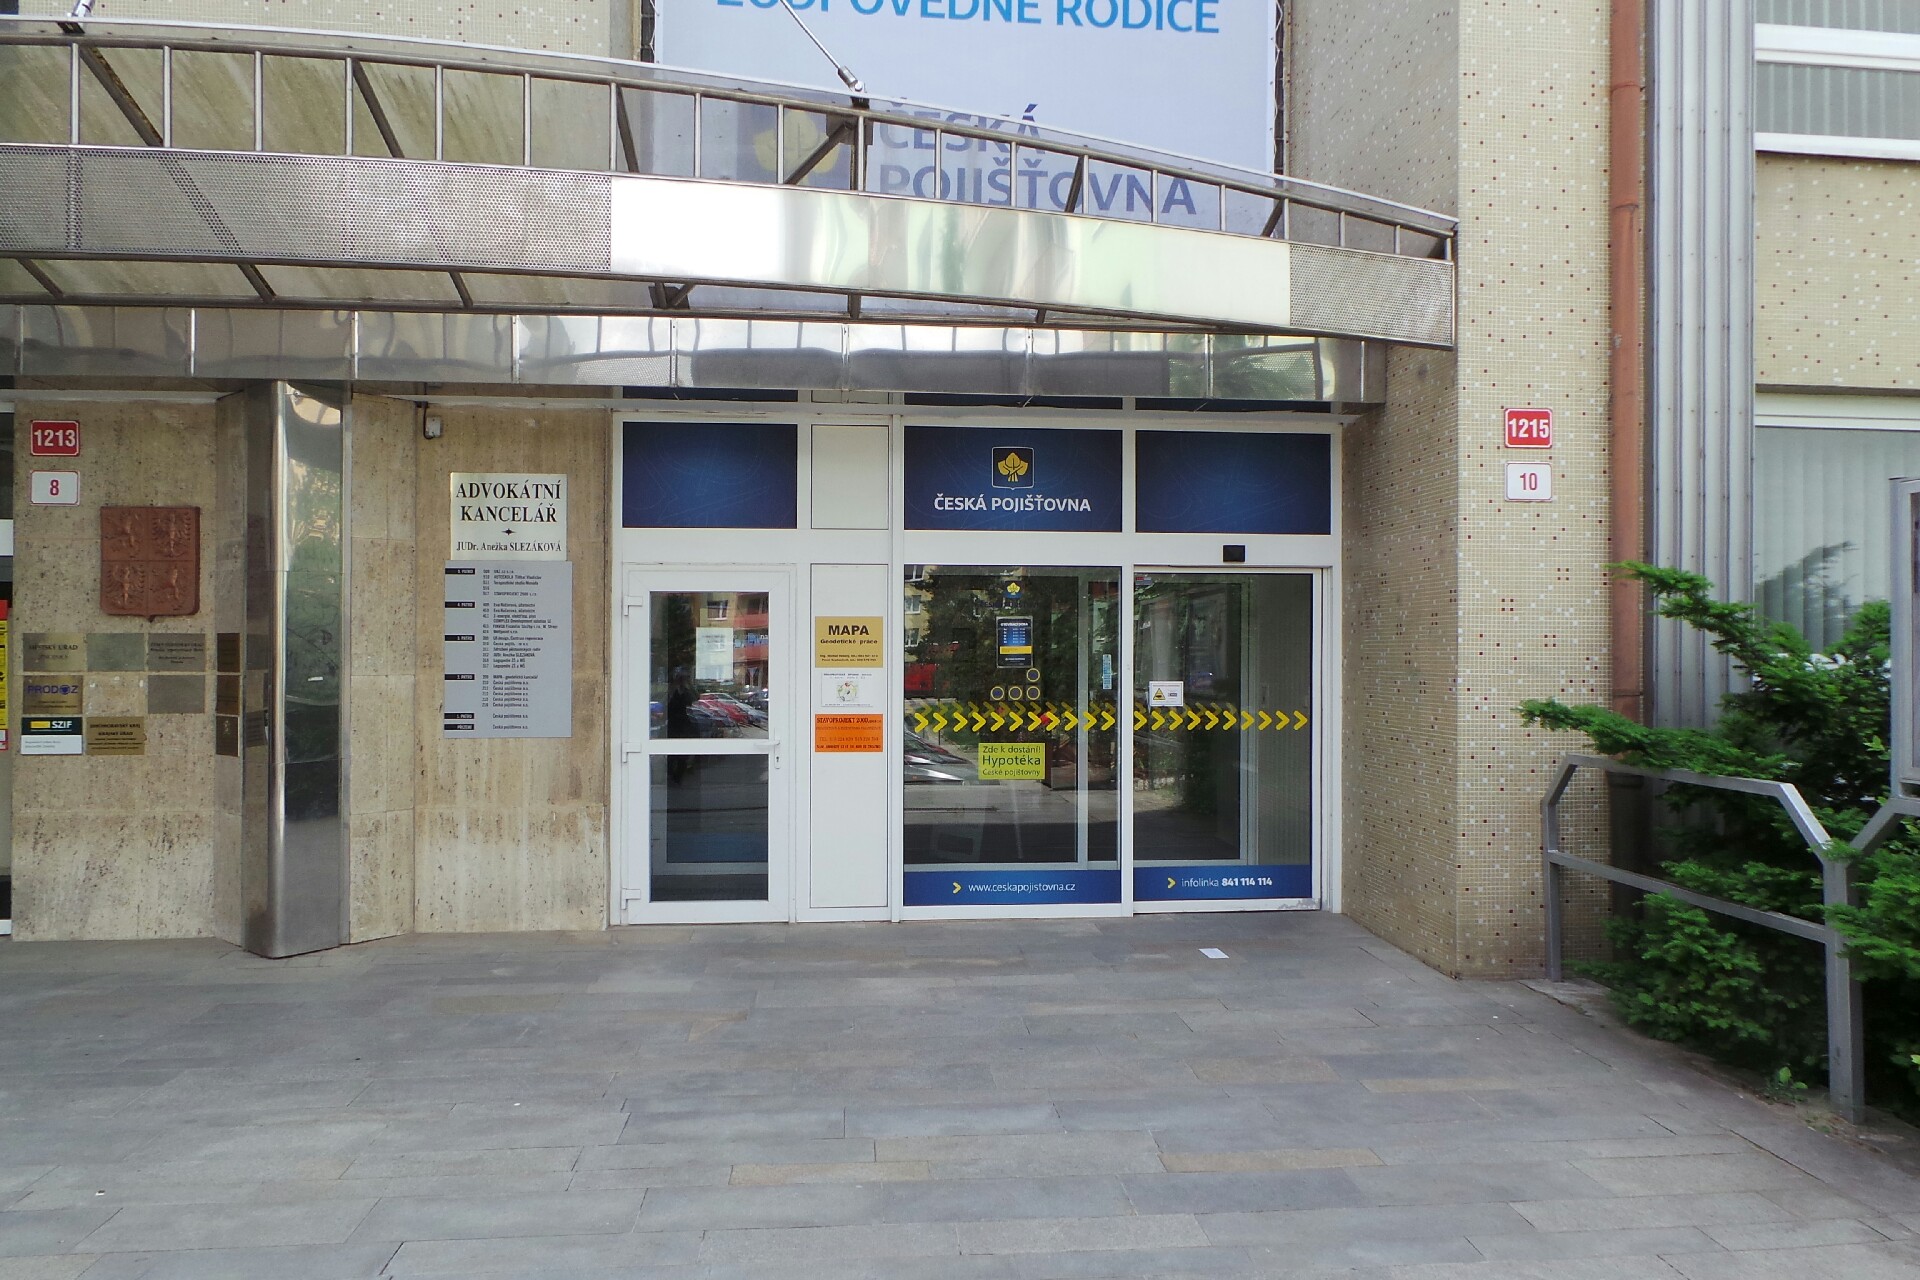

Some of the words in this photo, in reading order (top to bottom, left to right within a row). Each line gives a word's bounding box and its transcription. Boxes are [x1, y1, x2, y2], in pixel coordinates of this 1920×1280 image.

[1508, 418, 1550, 438] 1215
[33, 429, 76, 447] 1213
[49, 479, 59, 496] 8
[456, 479, 561, 499] ADVOKÁTNÍ
[1519, 473, 1538, 491] 10
[934, 493, 987, 511] ČESKÁ
[991, 493, 1091, 513] POJIŠŤOVNA
[460, 502, 557, 522] KANCELÁŘ
[456, 542, 479, 551] JUDr.
[481, 541, 507, 551] Anežka
[509, 540, 562, 552] SLEZÁKOVÁ
[828, 624, 870, 636] MAPA
[1008, 745, 1041, 753] dostání!
[982, 755, 1041, 768] Hypotéka
[968, 881, 1076, 895] www.ceskapojistovna.cz
[1181, 877, 1219, 887] infolinka
[1221, 878, 1239, 887] 841
[1240, 878, 1256, 887] 114
[1257, 878, 1273, 887] 114
